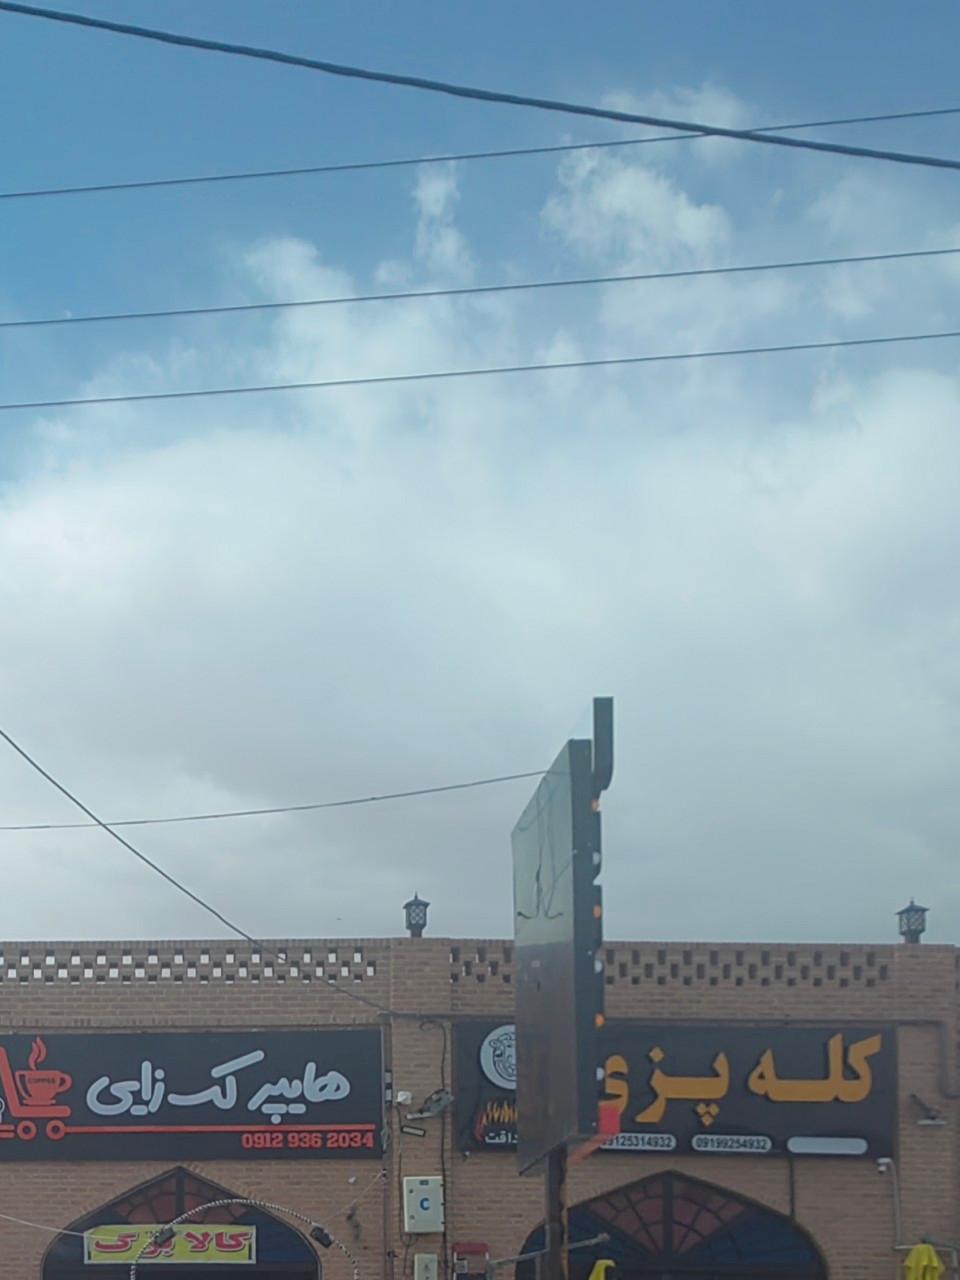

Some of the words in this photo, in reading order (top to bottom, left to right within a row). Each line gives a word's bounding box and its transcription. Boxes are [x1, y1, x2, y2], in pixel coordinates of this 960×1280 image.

[747, 1033, 882, 1103] کله
[246, 1061, 351, 1124] هایپر
[242, 1132, 283, 1148] 0912
[287, 1132, 322, 1148] 936
[326, 1131, 374, 1148] 2034
[419, 1197, 430, 1211] C
